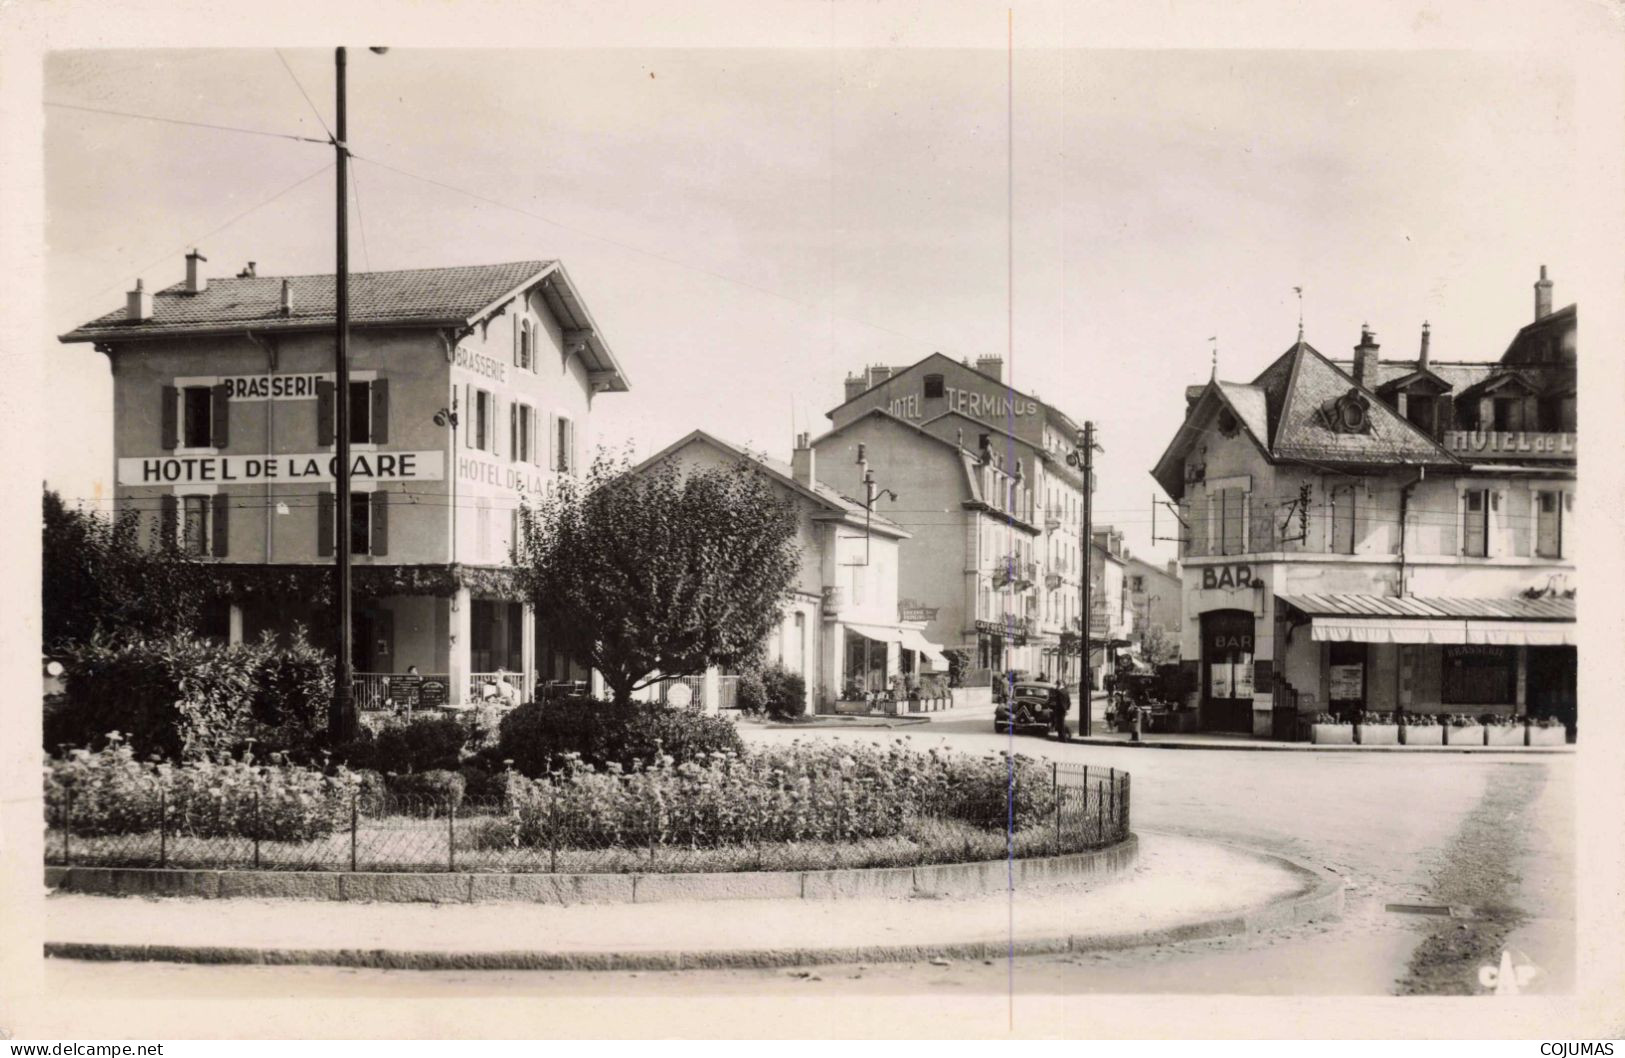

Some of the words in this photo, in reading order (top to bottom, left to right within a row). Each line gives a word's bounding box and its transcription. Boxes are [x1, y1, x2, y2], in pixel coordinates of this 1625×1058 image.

[456, 347, 505, 383] BRASSERIE
[224, 376, 323, 398] BRASSERIE
[945, 387, 1037, 417] TERMINUS
[143, 458, 236, 481] HOTEL
[246, 459, 278, 478] DE
[289, 458, 320, 477] LA
[459, 457, 503, 488] HOTEL
[507, 469, 523, 492] DE
[527, 474, 543, 496] LA
[1203, 565, 1251, 590] BAR
[1215, 635, 1252, 648] BAR
